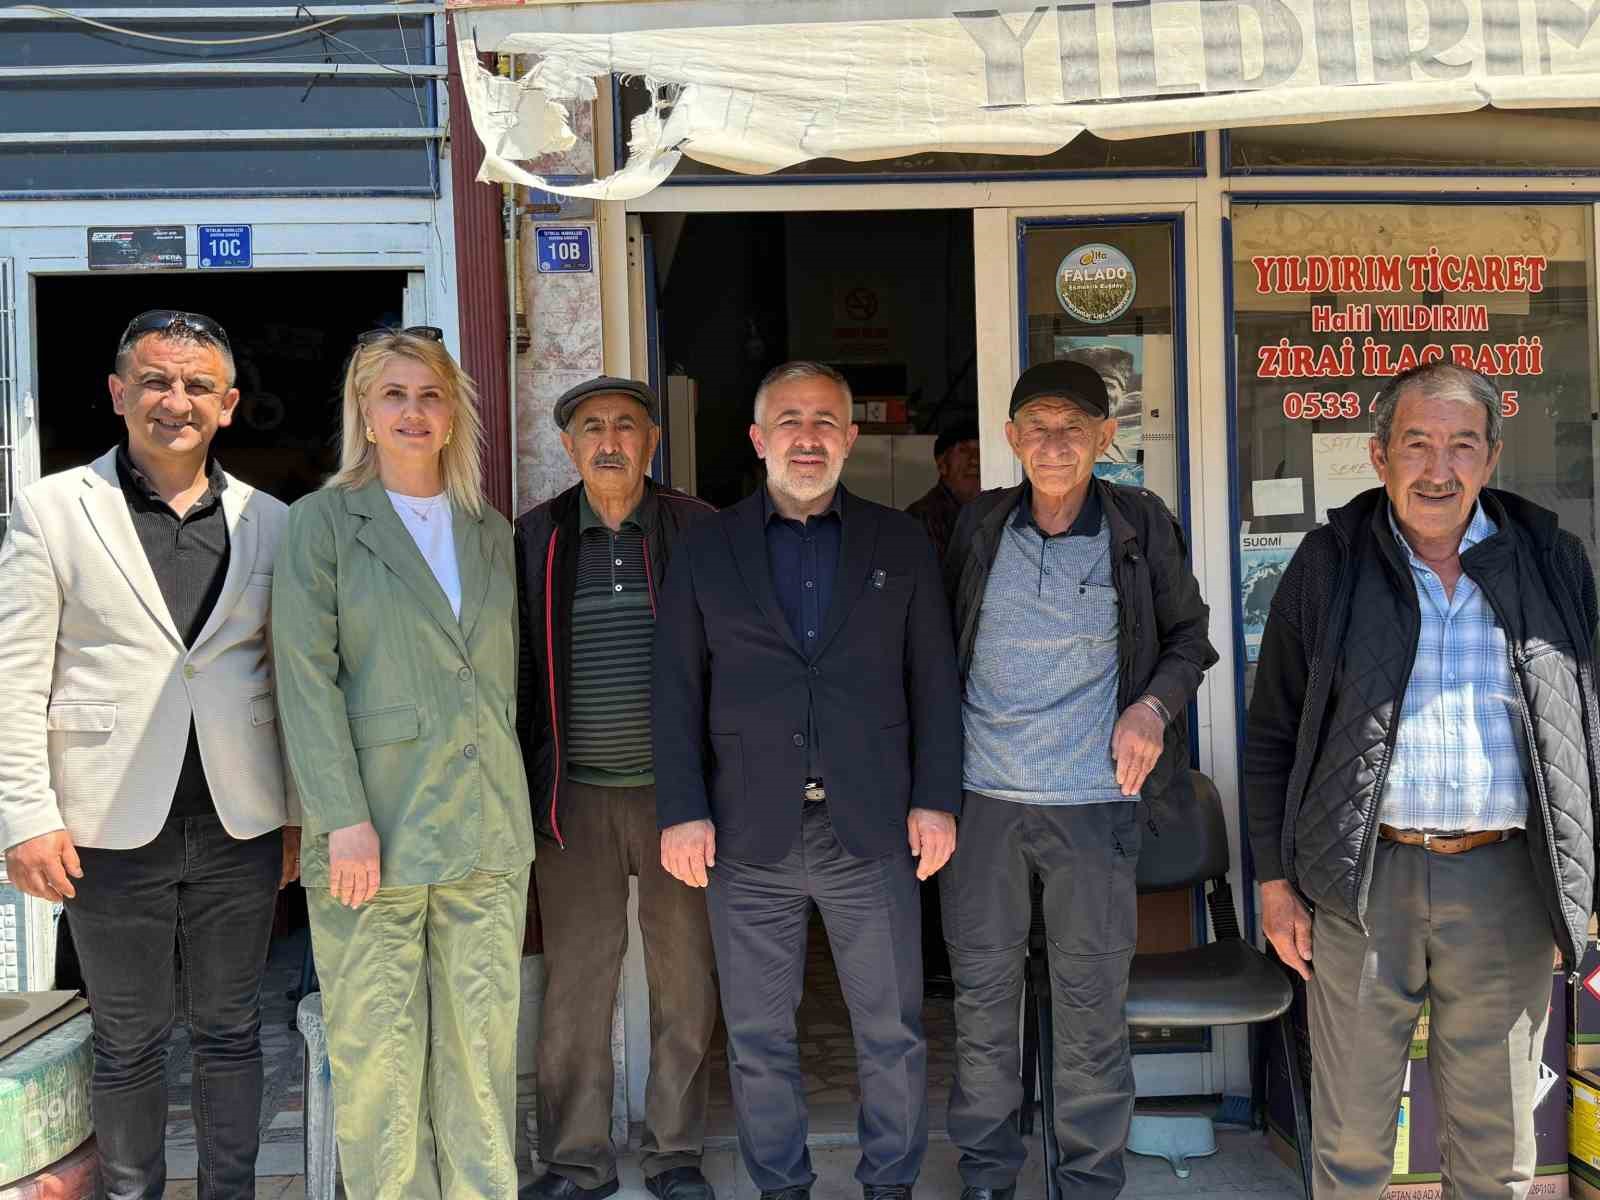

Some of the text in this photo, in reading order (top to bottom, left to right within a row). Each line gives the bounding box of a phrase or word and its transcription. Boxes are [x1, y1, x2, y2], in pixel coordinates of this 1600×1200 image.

[209, 239, 241, 257] 10C
[548, 242, 581, 260] 10B
[1064, 268, 1127, 282] FALADO
[1252, 247, 1547, 294] YILDIRIM TİCARET
[1312, 304, 1489, 333] Halil YILDIRIM
[1257, 337, 1355, 378] ZİRAİ
[1451, 335, 1544, 376] BAYİİ
[1283, 391, 1361, 420] 0533
